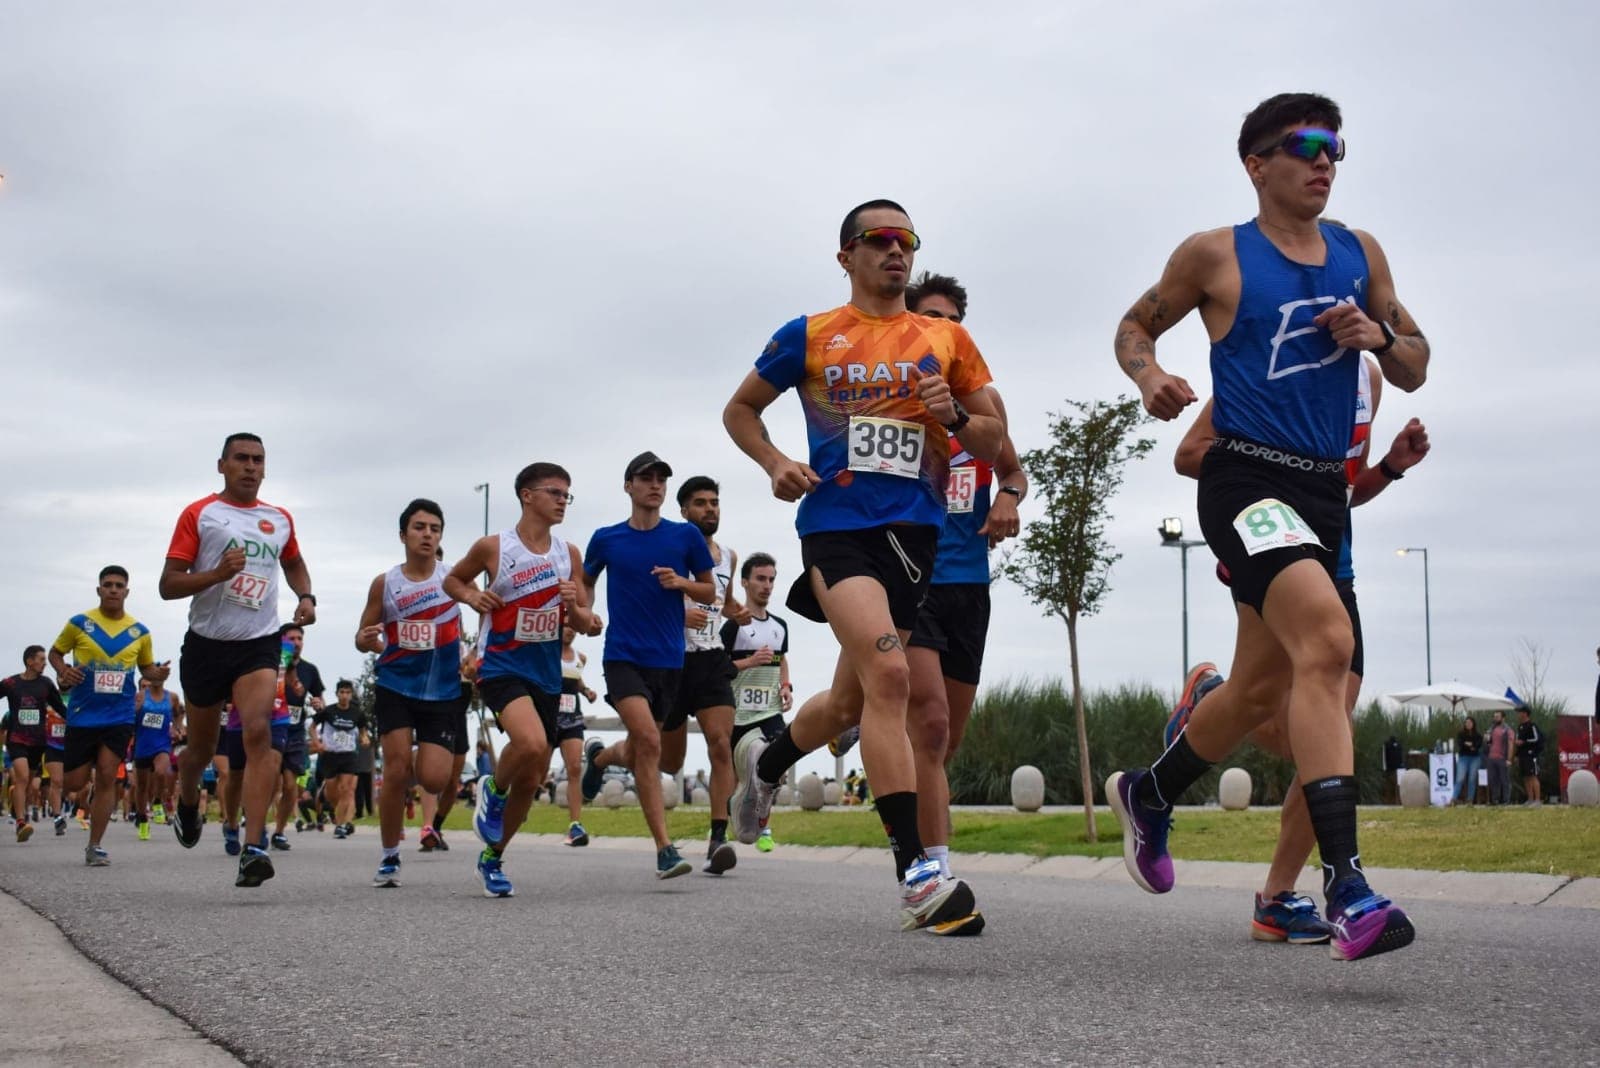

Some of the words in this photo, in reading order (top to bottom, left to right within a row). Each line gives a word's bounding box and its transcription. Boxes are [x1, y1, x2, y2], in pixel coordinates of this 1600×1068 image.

[824, 362, 914, 387] PRAT
[854, 422, 919, 463] 385
[1227, 439, 1314, 471] NORDICO
[945, 473, 970, 501] 45
[221, 537, 279, 560] ADN
[230, 576, 267, 599] 427
[400, 624, 432, 642] 409
[521, 611, 557, 633] 508
[97, 673, 123, 688] 492
[743, 688, 769, 705] 381
